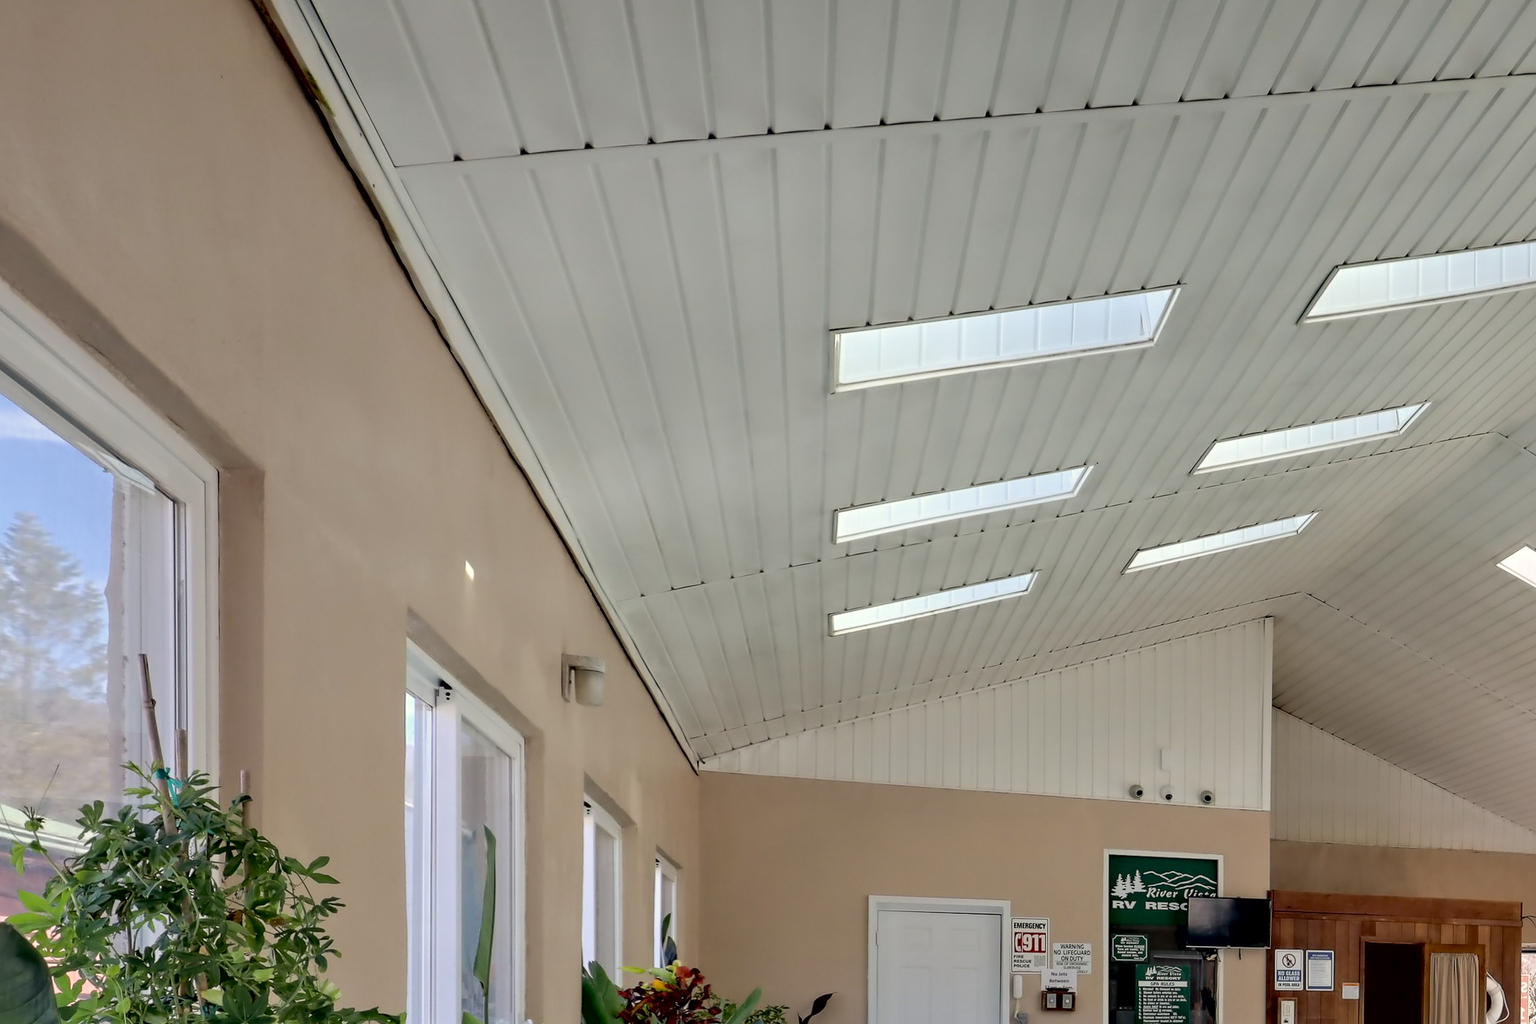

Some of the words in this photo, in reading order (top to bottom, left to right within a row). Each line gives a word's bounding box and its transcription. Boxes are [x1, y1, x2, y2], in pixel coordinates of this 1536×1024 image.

[1146, 887, 1178, 898] River
[1112, 900, 1137, 909] RV
[1145, 901, 1188, 911] RESO
[1013, 922, 1046, 930] EMERGENCY
[1022, 933, 1046, 952] 911
